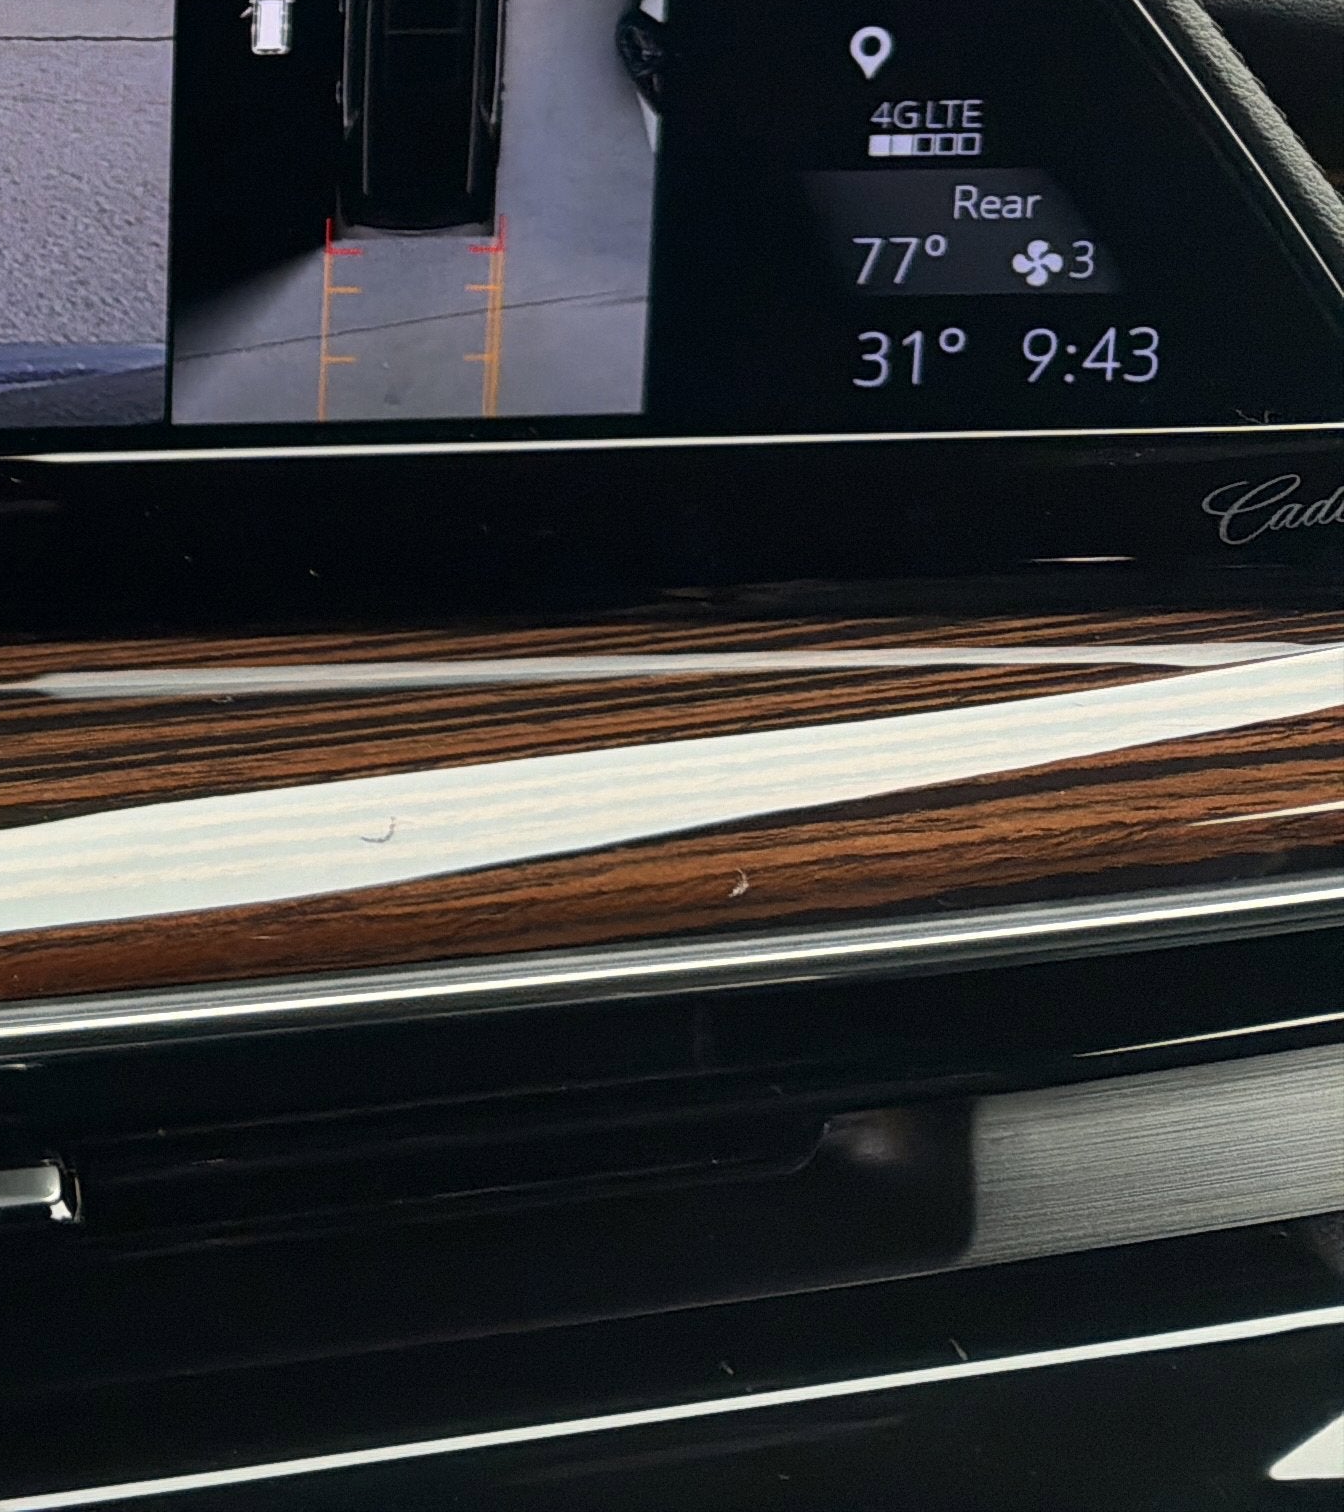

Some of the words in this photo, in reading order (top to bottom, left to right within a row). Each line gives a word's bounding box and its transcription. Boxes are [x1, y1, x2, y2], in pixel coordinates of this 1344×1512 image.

[953, 184, 1042, 220] Rear
[853, 234, 948, 284] 77°
[1069, 240, 1094, 279] 3
[852, 327, 967, 387] 31°
[1022, 326, 1160, 383] 9:43
